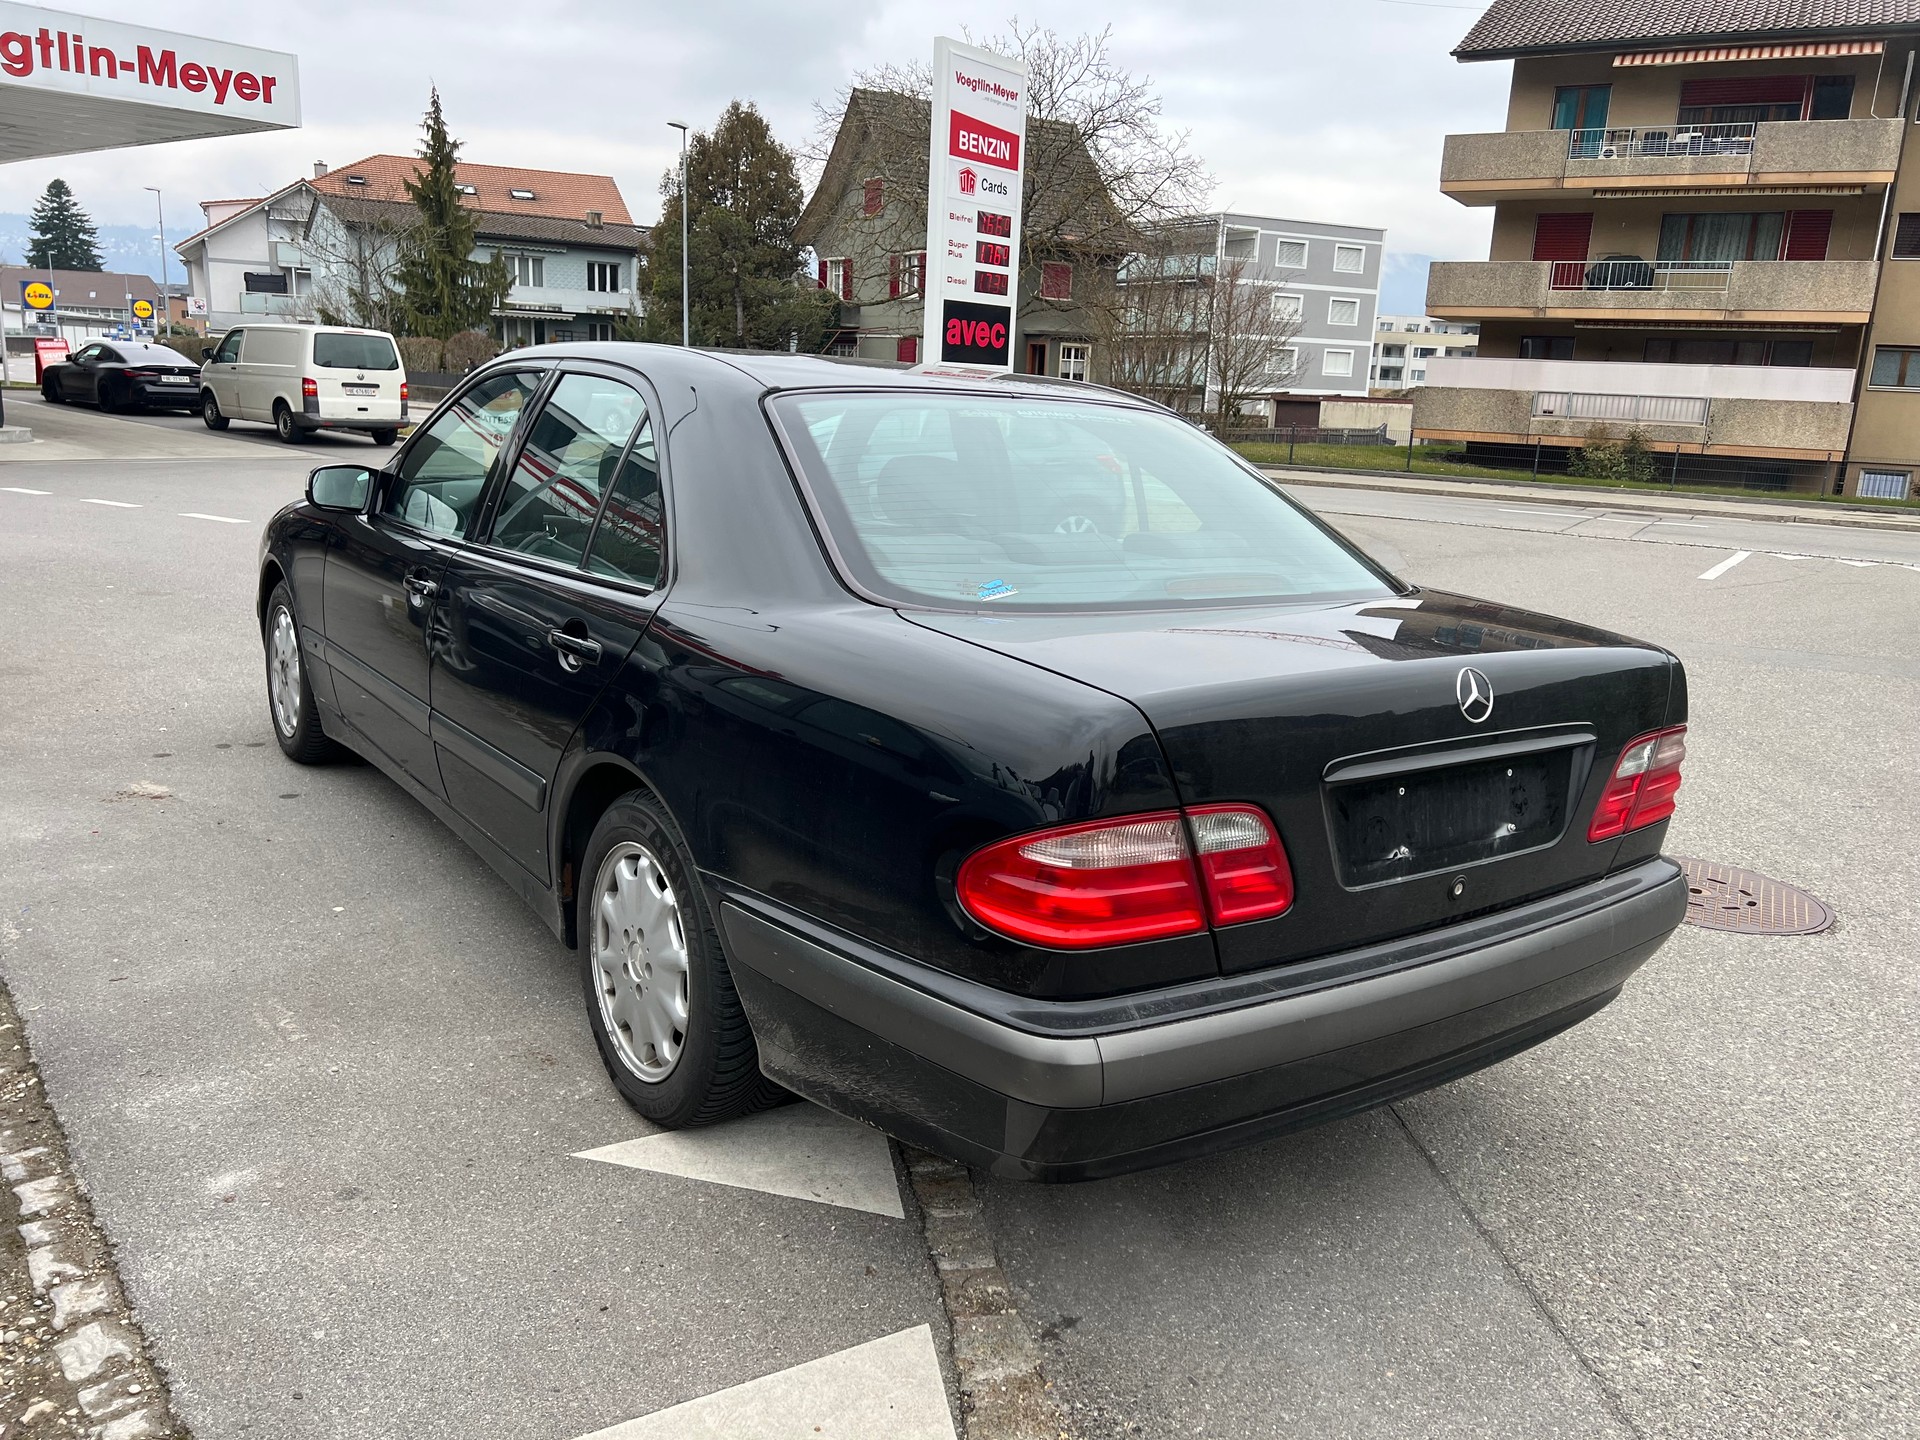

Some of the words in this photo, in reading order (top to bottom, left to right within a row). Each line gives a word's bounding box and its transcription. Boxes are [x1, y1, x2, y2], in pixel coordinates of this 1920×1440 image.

[955, 70, 1018, 102] Voegtlin-Meyer
[958, 129, 1010, 161] BENZIN
[981, 178, 1008, 196] Cards
[949, 212, 973, 223] Bleifrei
[948, 239, 969, 249] Super
[947, 249, 963, 258] Plus
[946, 275, 967, 285] Diesel
[946, 317, 1006, 349] avec
